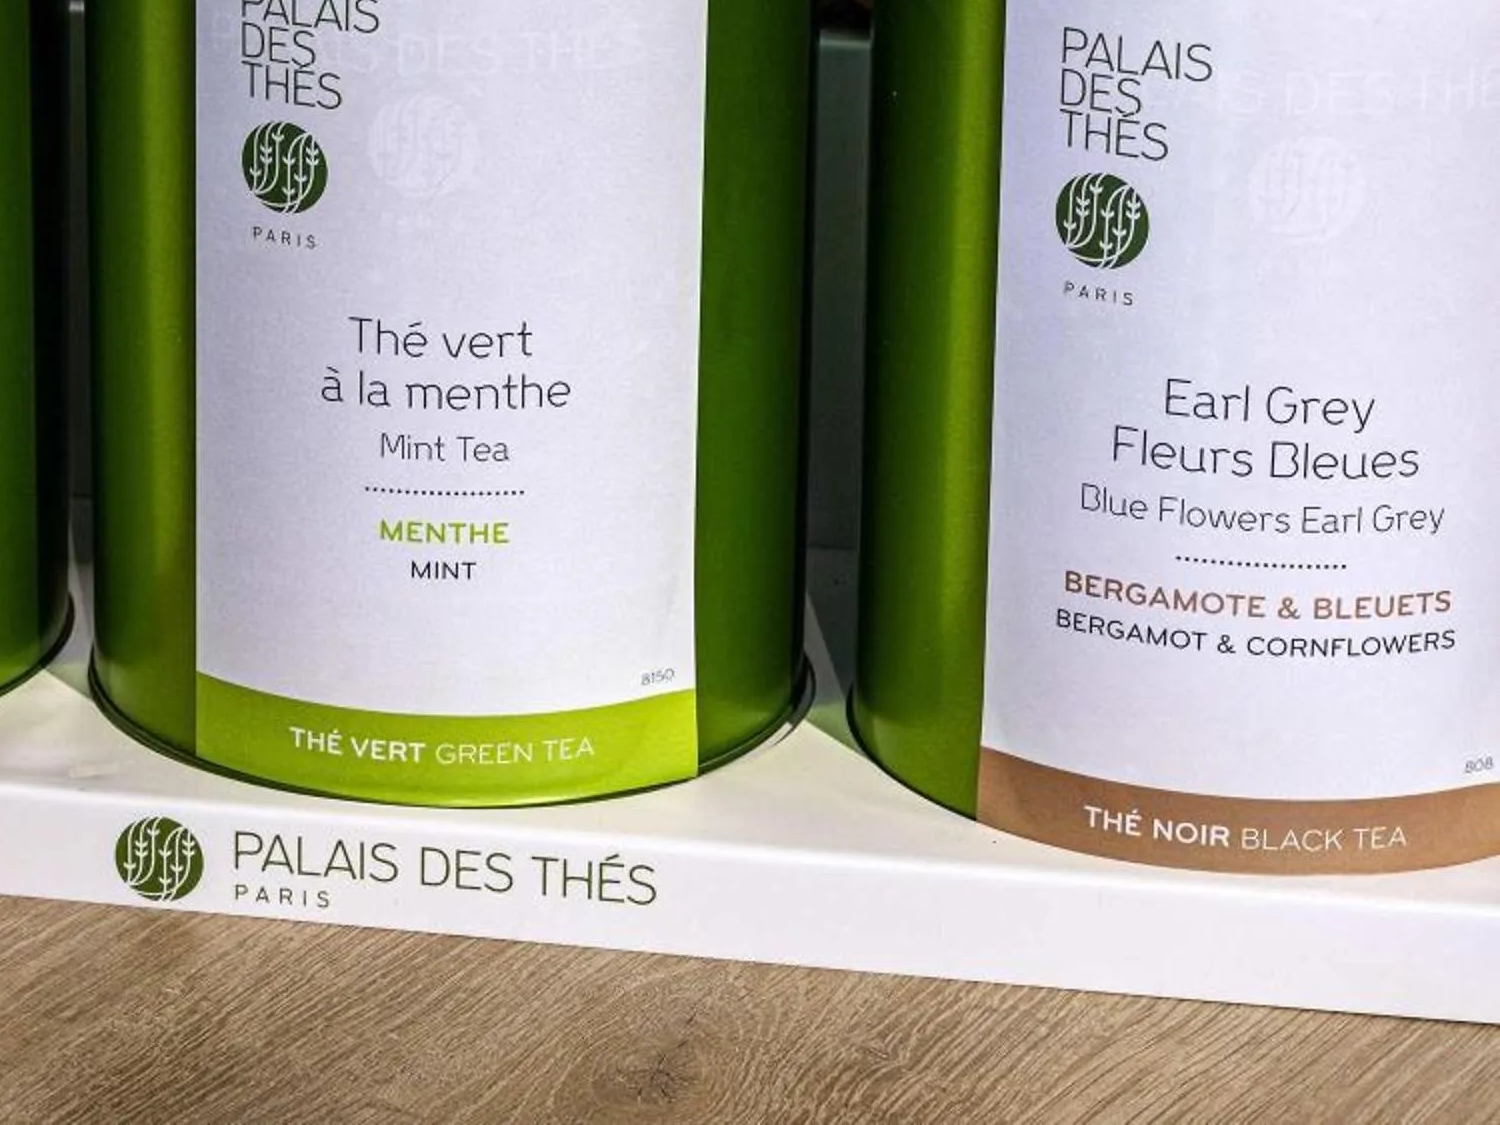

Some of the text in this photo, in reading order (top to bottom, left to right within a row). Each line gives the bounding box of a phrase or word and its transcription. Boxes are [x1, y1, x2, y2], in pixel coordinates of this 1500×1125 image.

[241, 21, 317, 67] DES
[1061, 27, 1214, 82] PALAIS
[1059, 68, 1143, 116] DES
[252, 226, 318, 250] PARIS
[1063, 280, 1135, 307] PARIS
[346, 315, 533, 357] Thé vert
[321, 366, 571, 411] à la menthe
[1164, 378, 1376, 433] Earl Grey
[380, 432, 510, 463] Mint Tea
[1112, 425, 1420, 480] Fleurs Bleues
[1080, 482, 1446, 535] Blue Flowers Earl Grey
[379, 519, 510, 545] MENTHE
[410, 561, 477, 581] MINT
[1064, 570, 1453, 620] BERGAMOTE & BLEUETS
[1056, 608, 1456, 658] BERGAMOT & CORNFLOWERS
[288, 727, 595, 766] THÉ VERT GREEN TEA
[1084, 805, 1408, 852] THÉ NOIR BLACK TEA
[233, 830, 658, 906] PALAIS DES THÉS
[234, 885, 330, 908] PARIS
